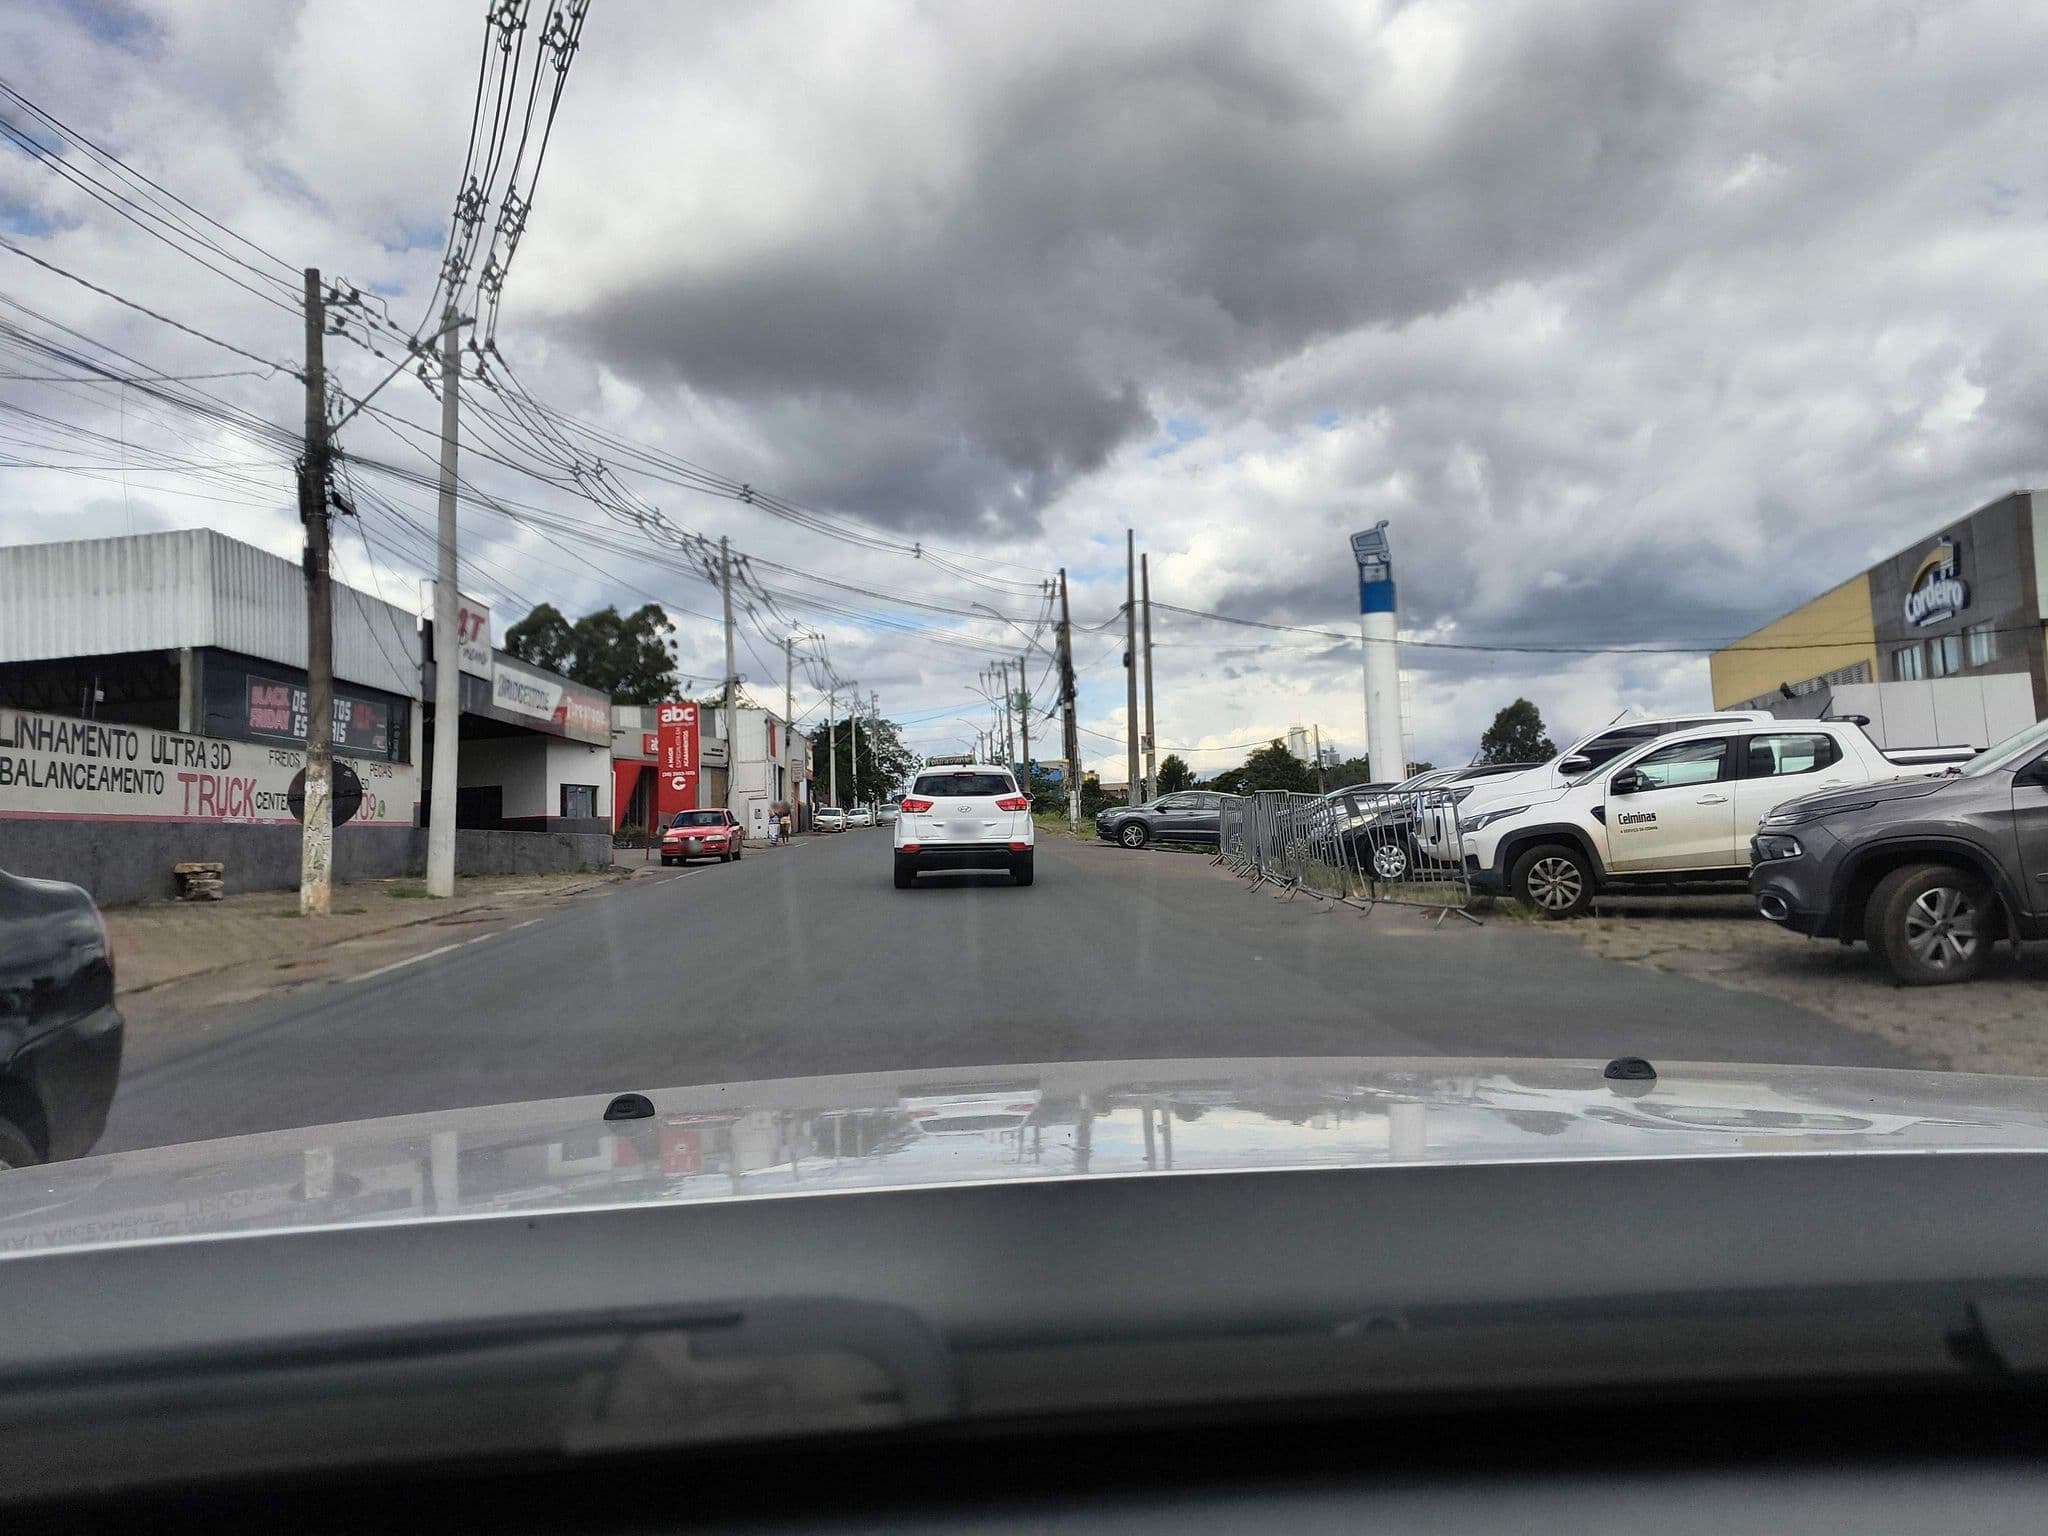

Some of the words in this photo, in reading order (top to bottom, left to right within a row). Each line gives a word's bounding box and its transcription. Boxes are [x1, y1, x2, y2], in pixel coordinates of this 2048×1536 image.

[1905, 574, 1964, 623] Cordeiro
[661, 706, 695, 722] abc
[151, 735, 206, 768] ULTRA
[210, 743, 231, 770] 3D
[269, 750, 300, 768] FREIOS
[0, 756, 164, 795] BALANCEAMENTO
[177, 773, 257, 817] TRUCK
[1618, 811, 1657, 825] Celminas
